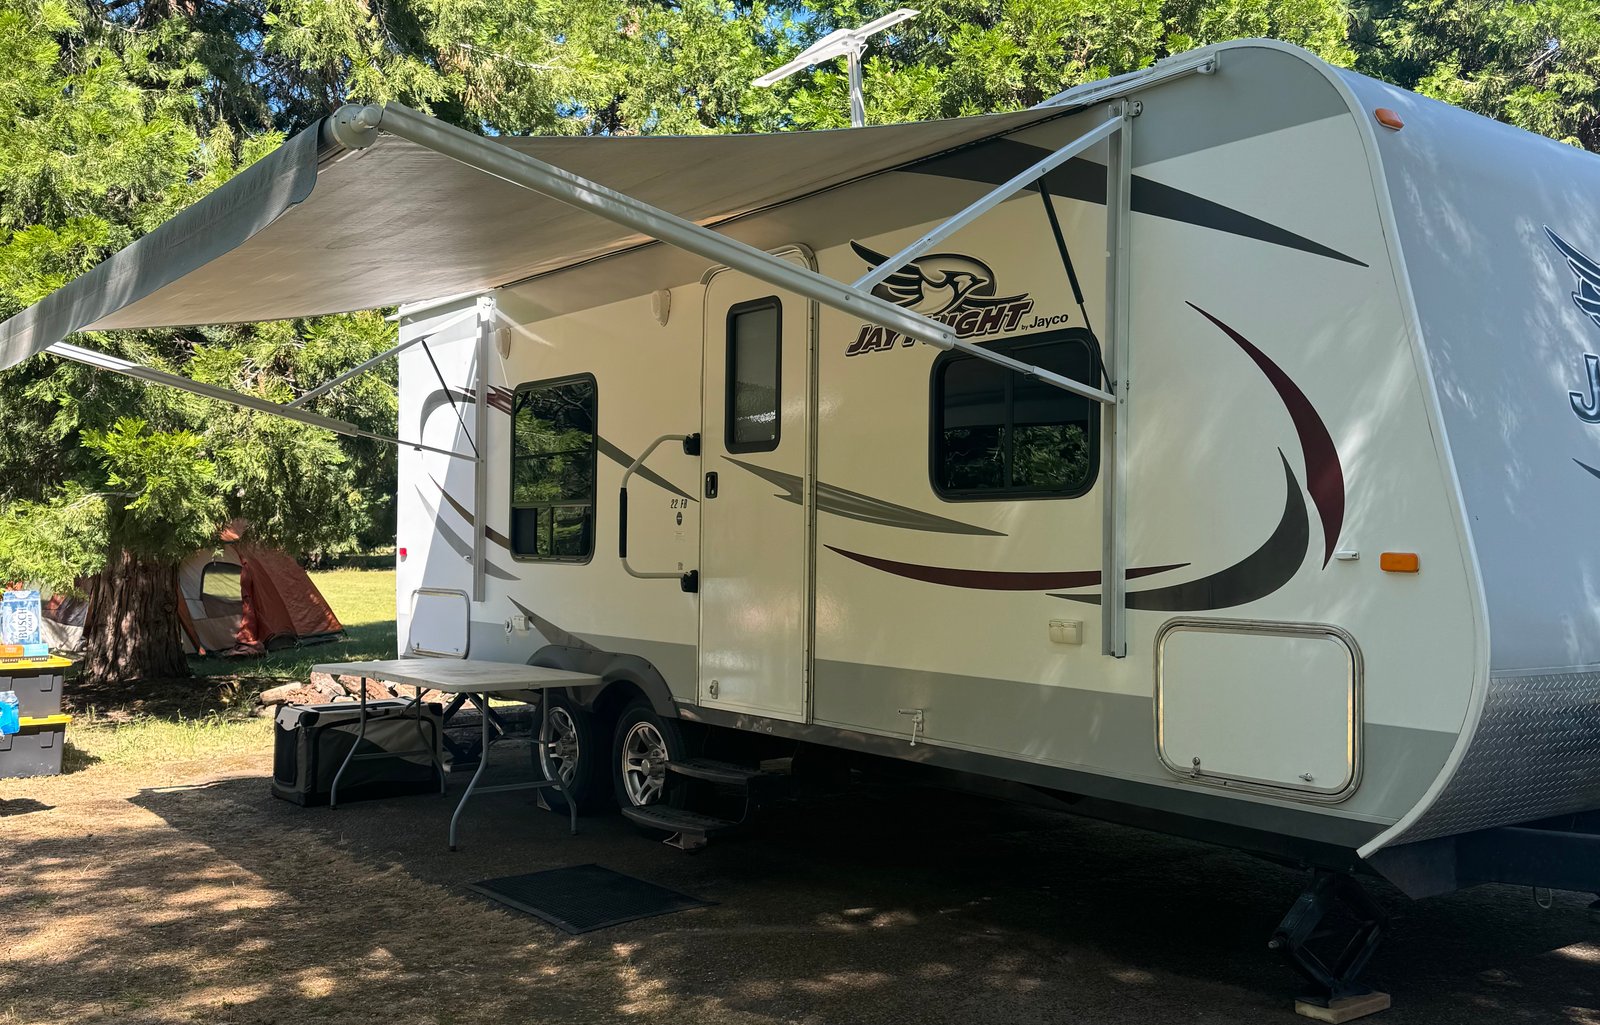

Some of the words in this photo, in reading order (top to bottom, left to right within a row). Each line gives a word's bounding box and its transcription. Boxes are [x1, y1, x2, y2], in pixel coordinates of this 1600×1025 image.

[845, 324, 901, 357] JAY
[902, 299, 1034, 347] IGHT
[1030, 314, 1068, 328] Jayco
[670, 498, 679, 508] 22
[18, 608, 28, 638] BUSCH
